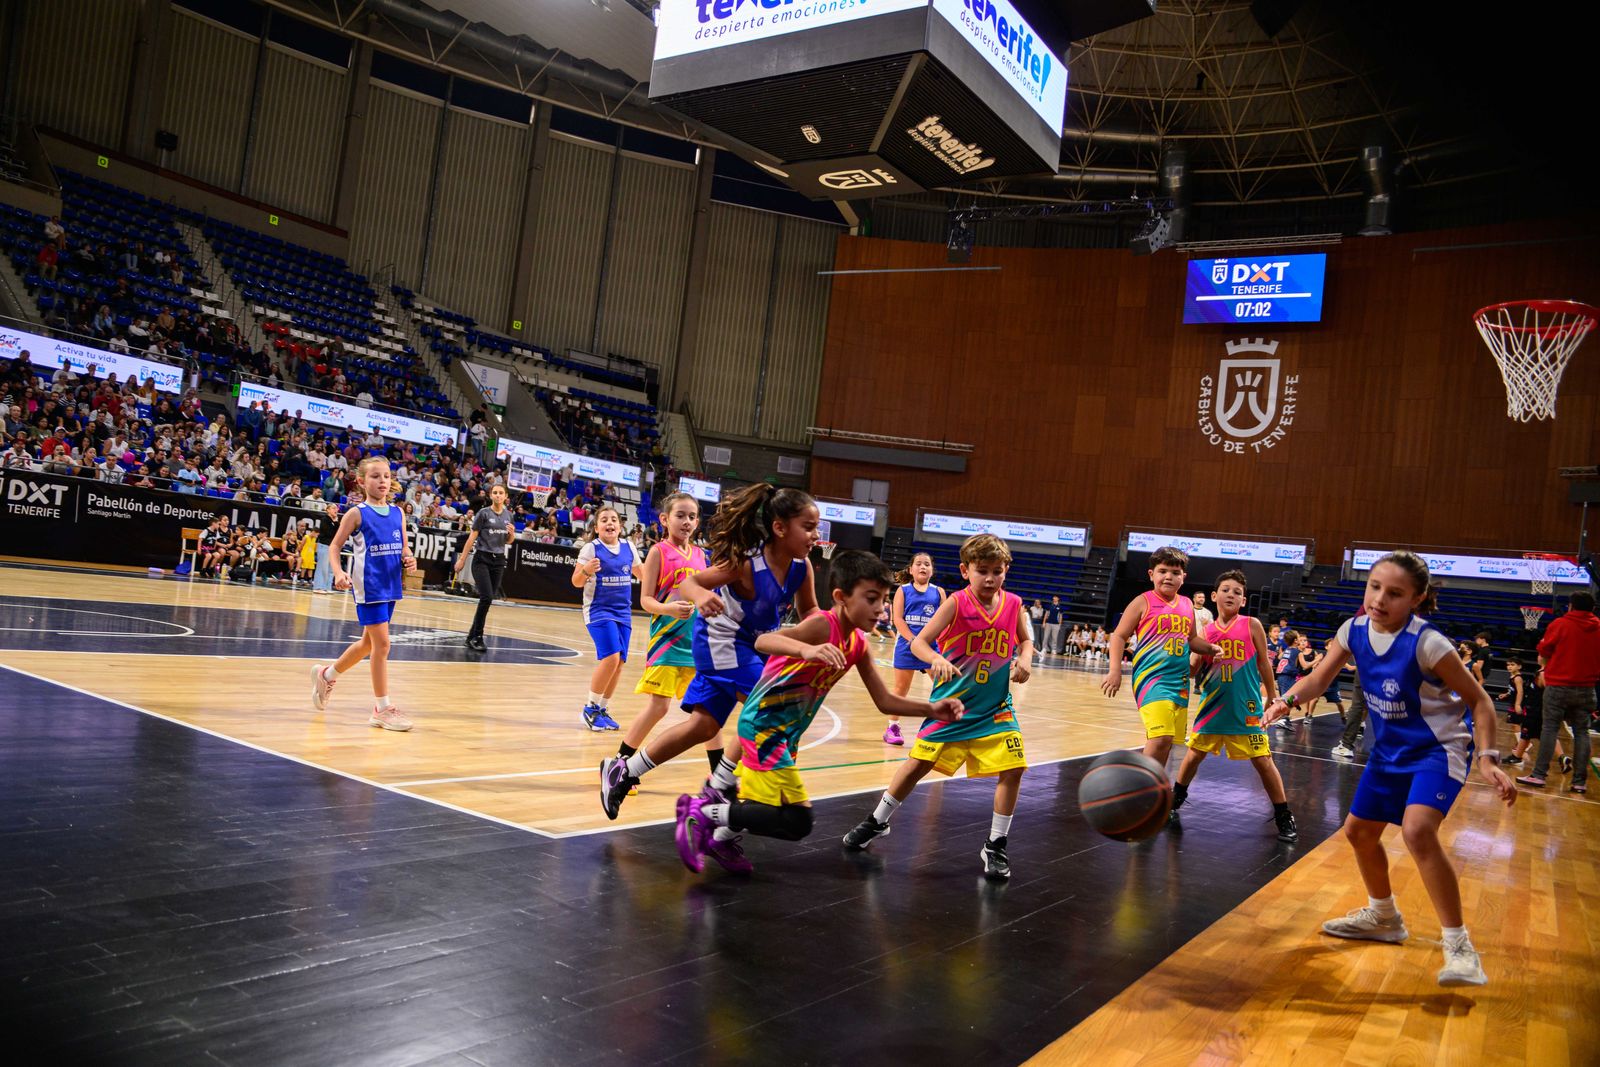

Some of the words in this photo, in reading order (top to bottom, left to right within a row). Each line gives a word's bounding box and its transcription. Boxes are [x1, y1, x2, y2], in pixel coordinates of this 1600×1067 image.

[694, 17, 764, 40] despierta
[771, 0, 854, 24] emociones
[960, 10, 999, 56] despierta
[1001, 54, 1038, 98] emociones
[1232, 262, 1290, 283] DXT
[1231, 284, 1282, 295] TENERIFE
[1235, 302, 1272, 317] 07:02
[55, 344, 84, 357] Activa
[86, 350, 96, 359] tu
[98, 354, 117, 364] vida
[366, 413, 387, 422] Activa
[396, 419, 409, 427] vida
[1198, 375, 1222, 445] CABILDO
[1223, 440, 1246, 454] DE
[1250, 374, 1300, 454] TENERIFE
[7, 479, 69, 505] DXT
[7, 503, 60, 519] TENERIFE
[87, 493, 143, 513] Pabellón
[145, 501, 161, 514] de
[163, 503, 214, 521] Deportes
[87, 507, 112, 518] Santiago
[1219, 541, 1238, 549] Activa
[521, 549, 552, 562] Pabellón
[554, 551, 563, 563] de
[1156, 613, 1191, 638] CBG
[966, 627, 1010, 659] CBG
[1162, 636, 1185, 657] 46
[1217, 638, 1246, 661] BG
[975, 660, 992, 684] 6
[1221, 663, 1233, 683] 11
[1006, 737, 1022, 749] CB
